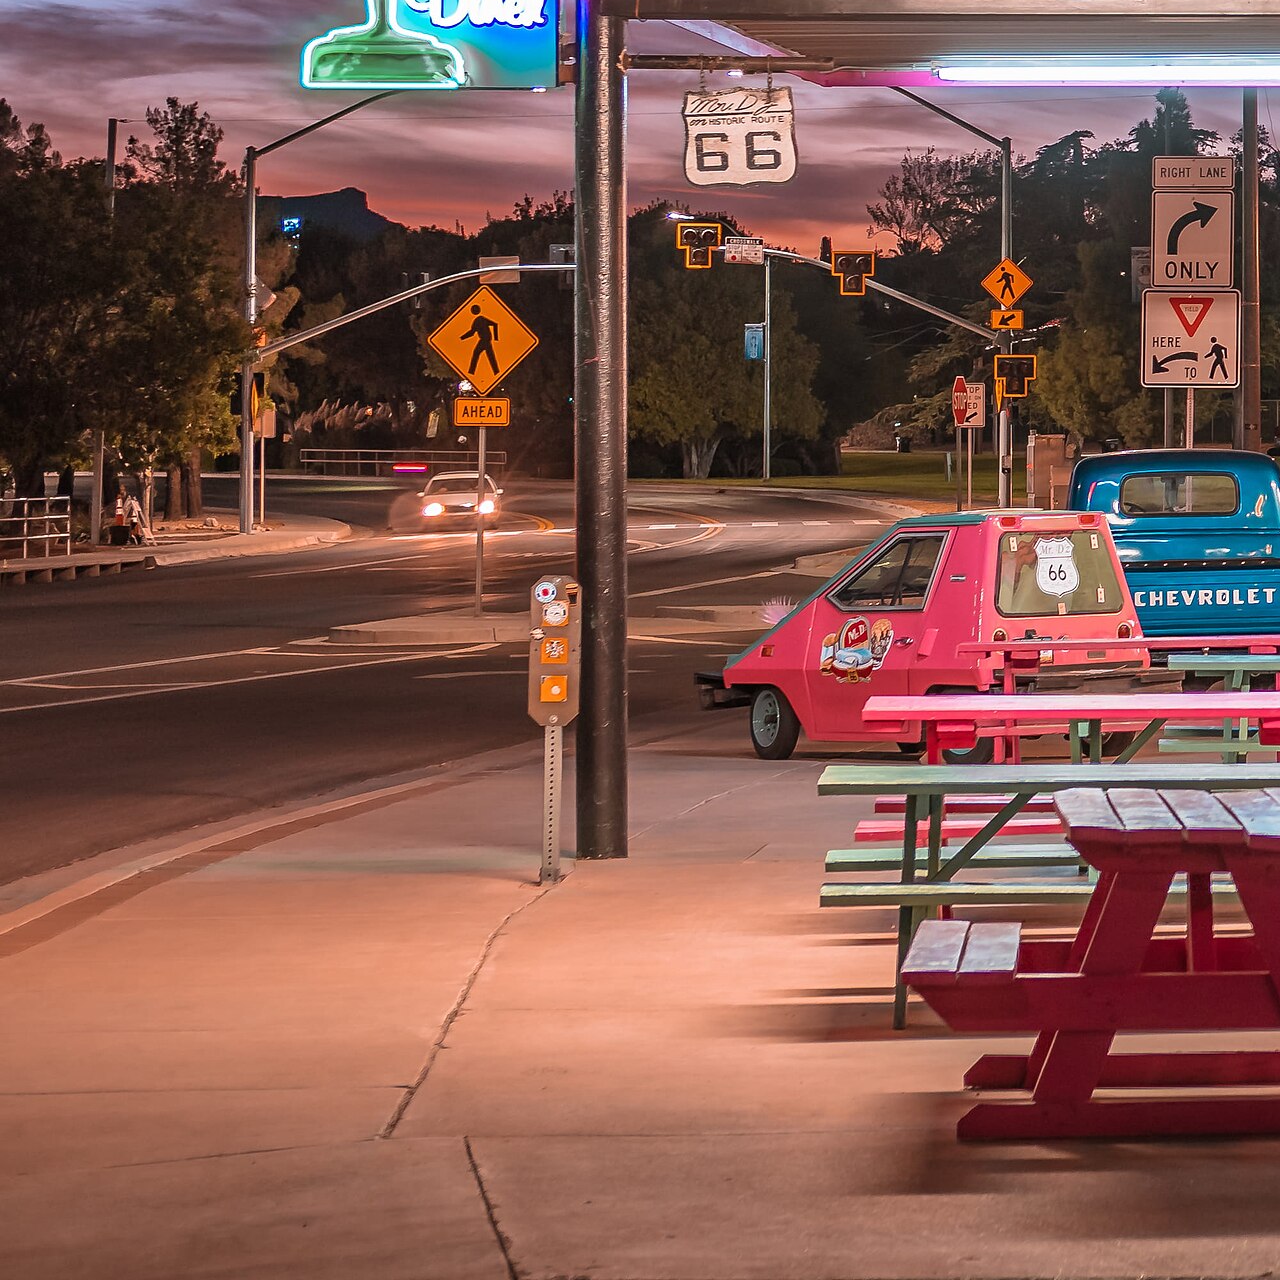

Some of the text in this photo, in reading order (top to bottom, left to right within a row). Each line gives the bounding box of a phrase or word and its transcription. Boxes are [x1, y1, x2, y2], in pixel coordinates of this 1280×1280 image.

[689, 115, 785, 127] on HISTORIC ROUTE
[694, 131, 782, 172] 66
[1160, 167, 1227, 178] RIGHT LANE
[1165, 261, 1220, 280] ONLY
[1152, 336, 1182, 348] HERE
[1184, 367, 1197, 379] TO
[954, 392, 966, 410] STOP
[462, 405, 502, 418] AHEAD
[1048, 564, 1067, 581] 66
[1134, 588, 1277, 607] CHEVROLET
